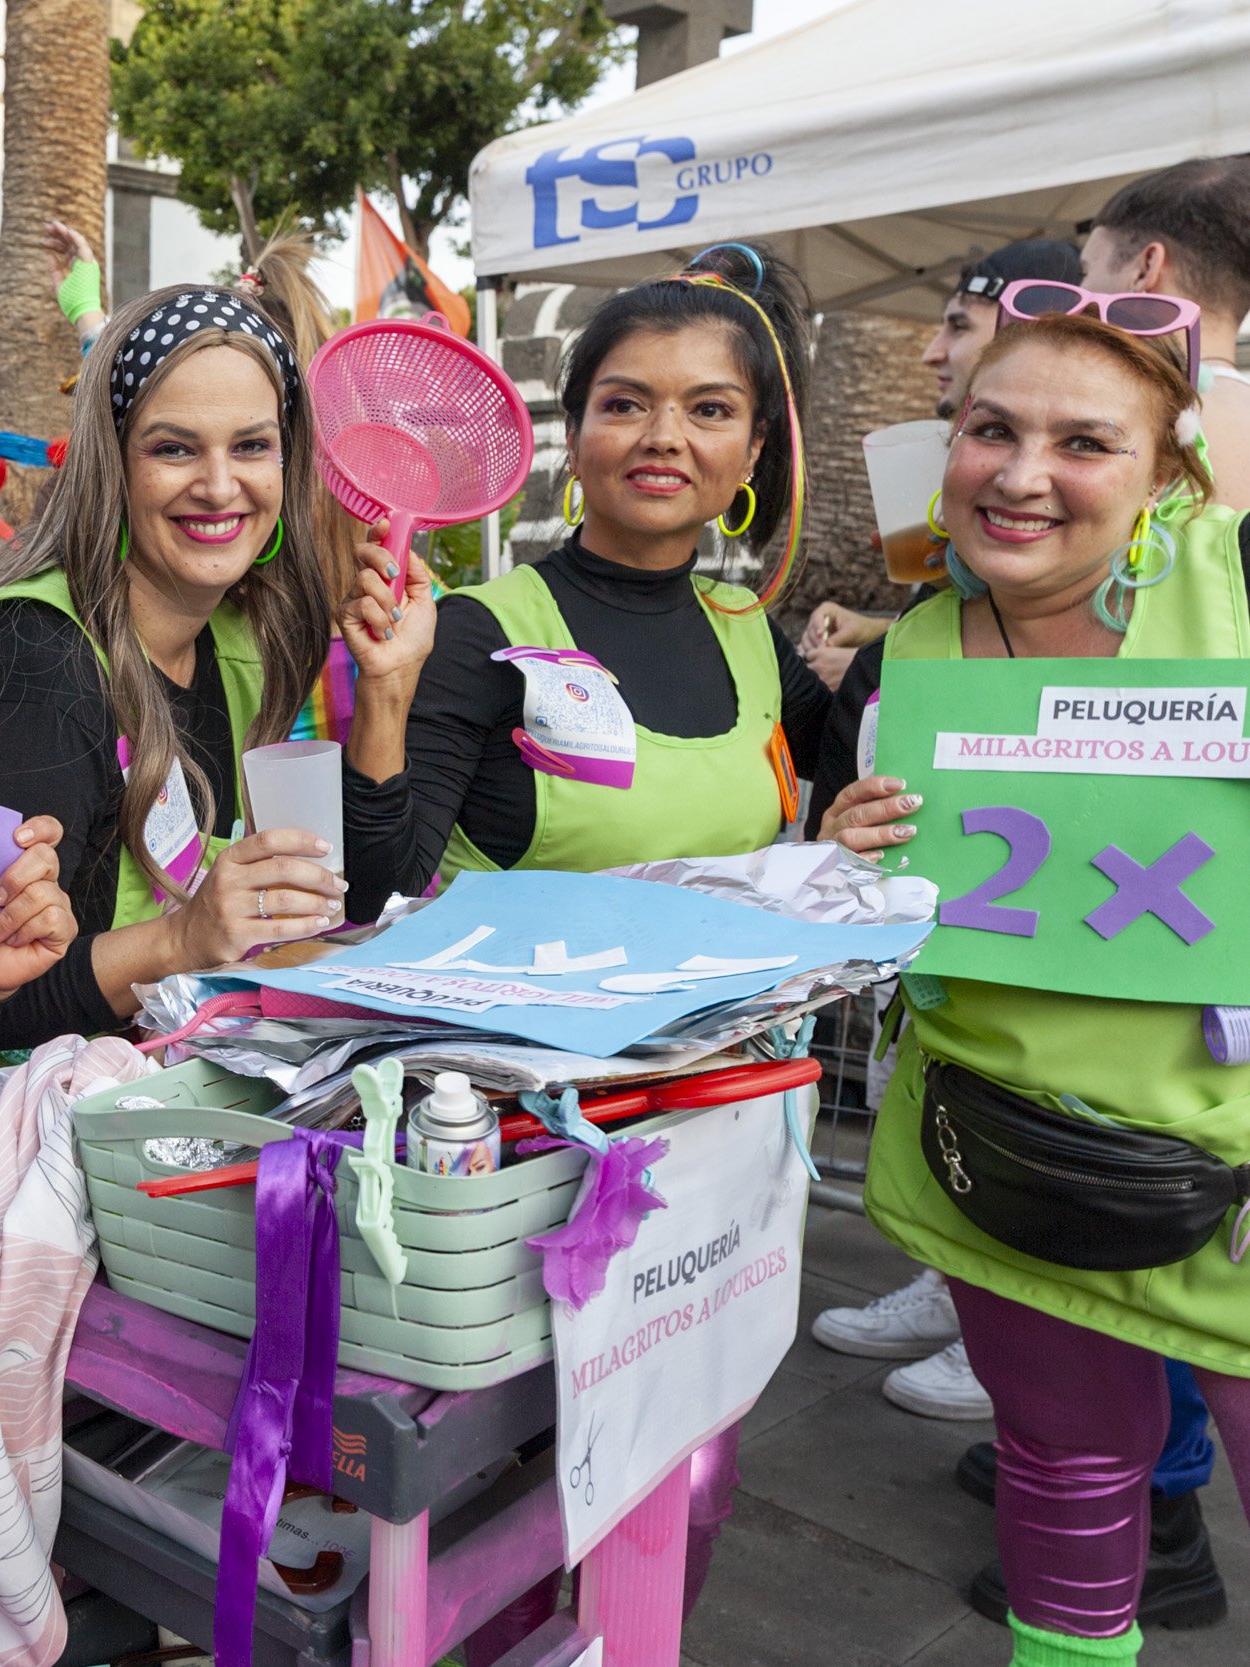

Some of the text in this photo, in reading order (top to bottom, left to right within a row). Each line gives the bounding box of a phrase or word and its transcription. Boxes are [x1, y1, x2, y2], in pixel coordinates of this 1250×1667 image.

[676, 152, 773, 191] GRUPO
[1053, 693, 1238, 725] PELUQUERÍA
[957, 737, 1145, 762] MILAGRITOS
[1150, 741, 1175, 762] A
[633, 1219, 741, 1304] PELUQUERÍA
[570, 1246, 788, 1400] MILAGRITOS A LOURDES
